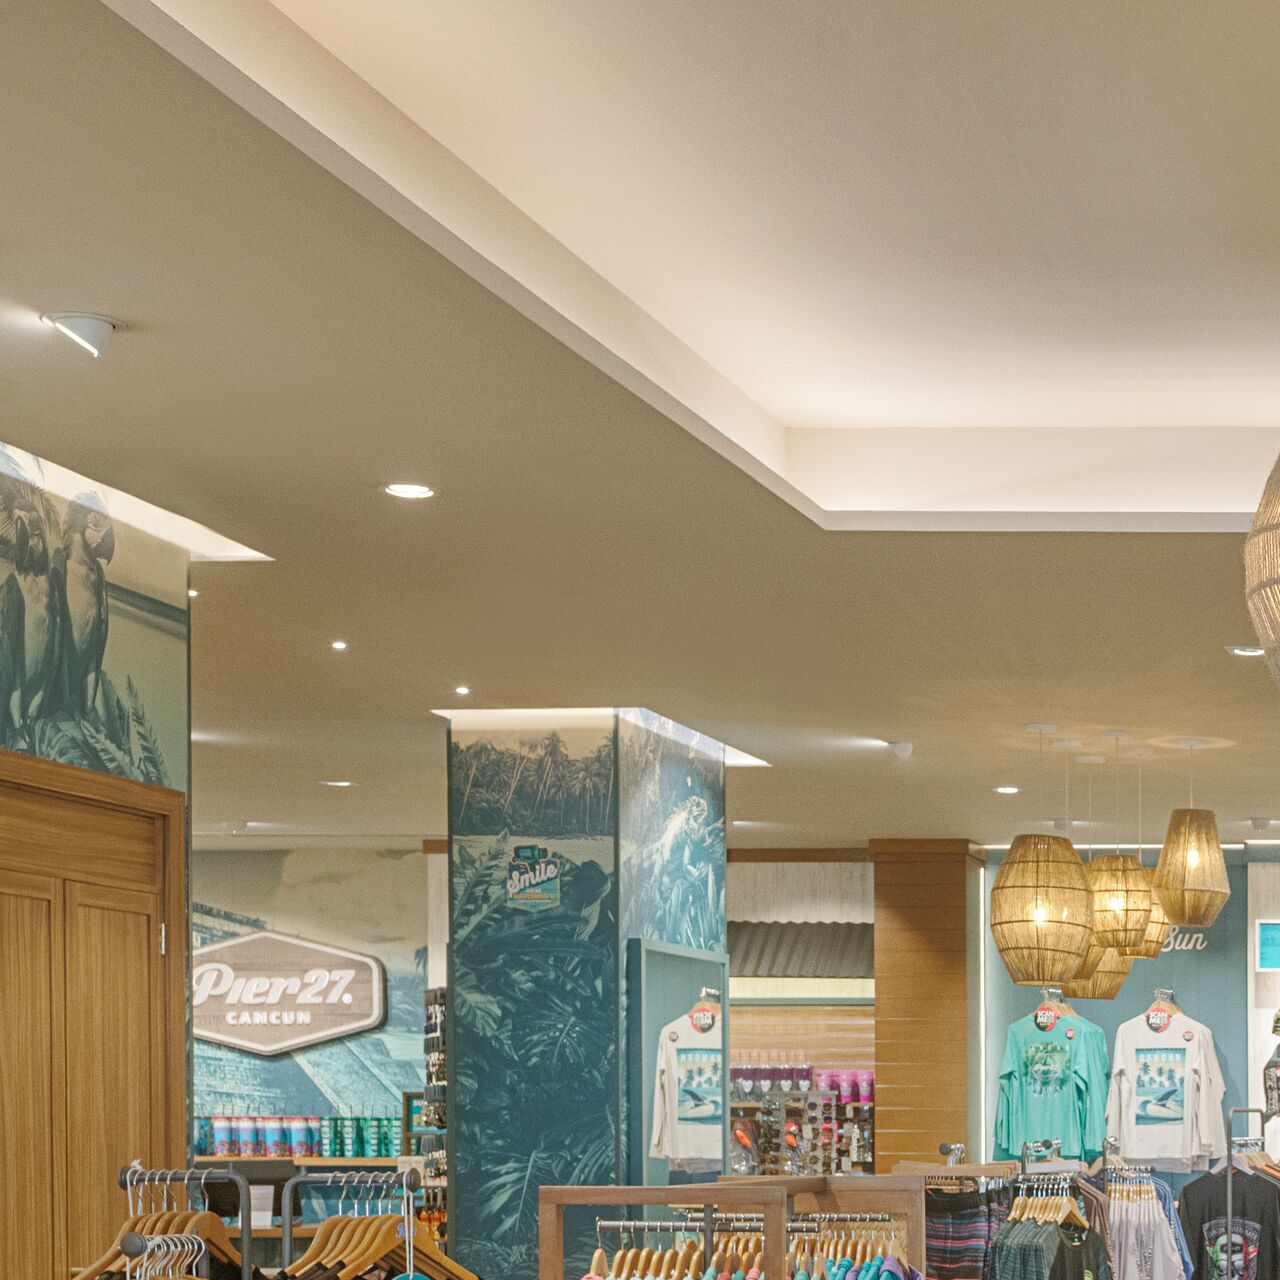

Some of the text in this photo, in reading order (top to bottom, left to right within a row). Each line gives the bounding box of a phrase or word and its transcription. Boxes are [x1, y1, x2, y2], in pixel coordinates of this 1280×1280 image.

[507, 864, 558, 898] Smile
[1162, 926, 1208, 953] Sun
[225, 1010, 311, 1026] CANCUN
